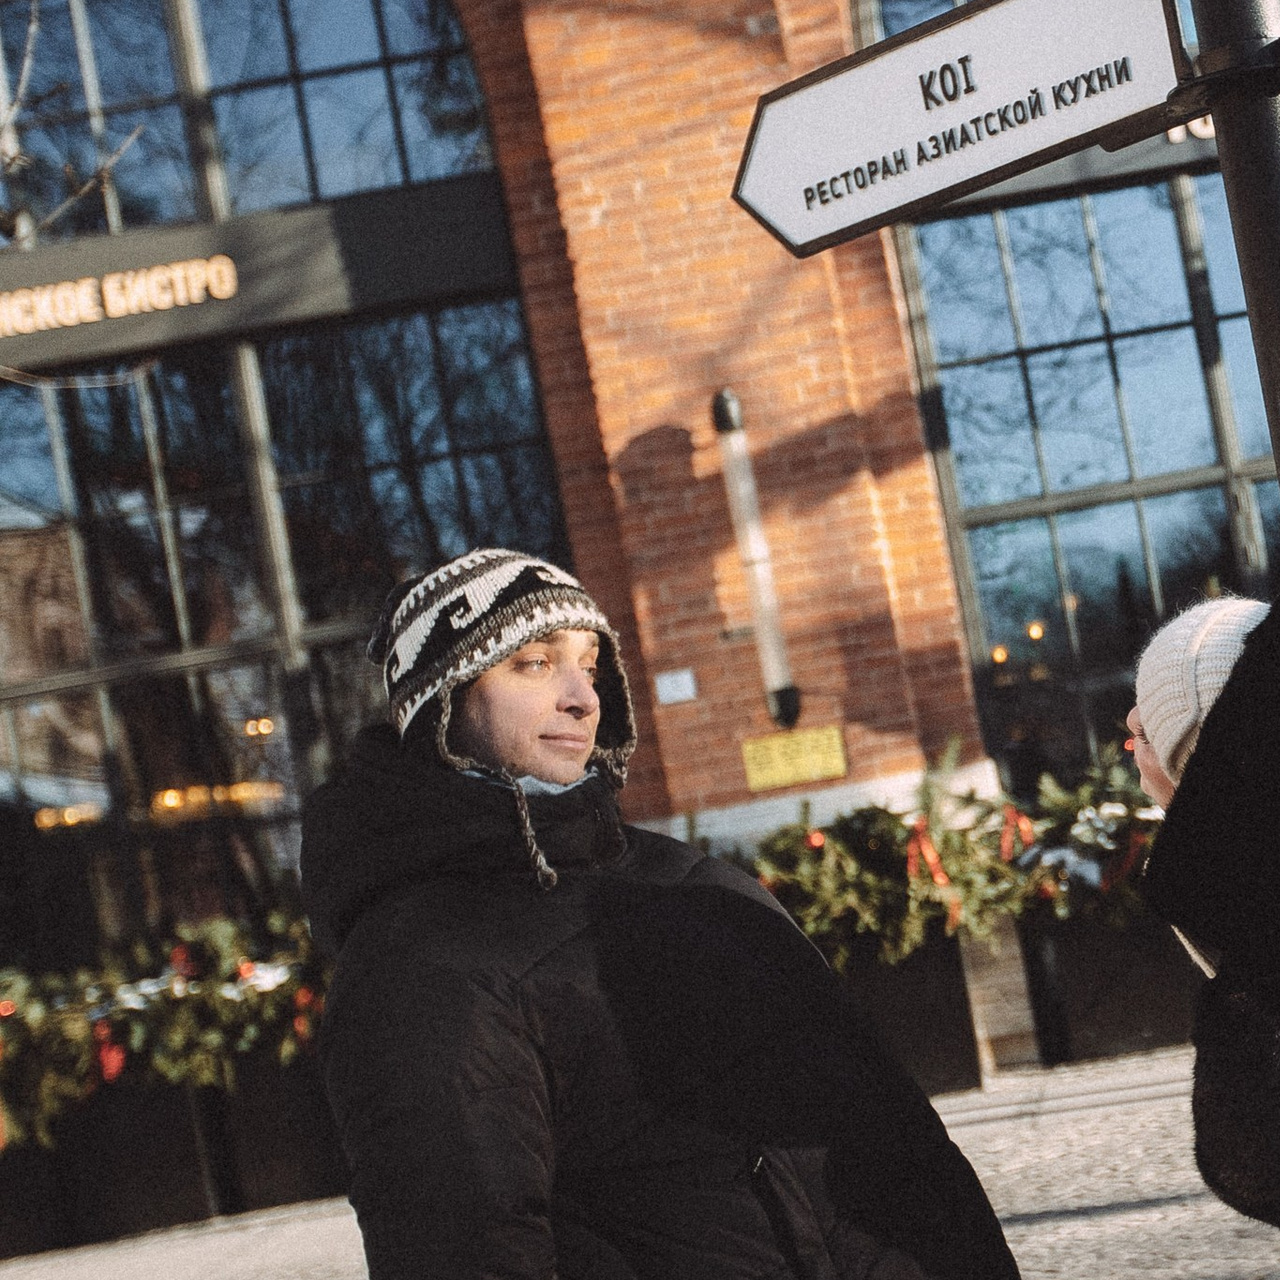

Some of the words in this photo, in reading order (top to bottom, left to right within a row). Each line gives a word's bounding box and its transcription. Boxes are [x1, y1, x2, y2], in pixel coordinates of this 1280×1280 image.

[803, 148, 910, 210] РЕСТОРАН
[917, 89, 1046, 167] АЗИАТСКОЙ
[1051, 56, 1133, 110] КУХНИ
[102, 254, 238, 318] БИСТРО
